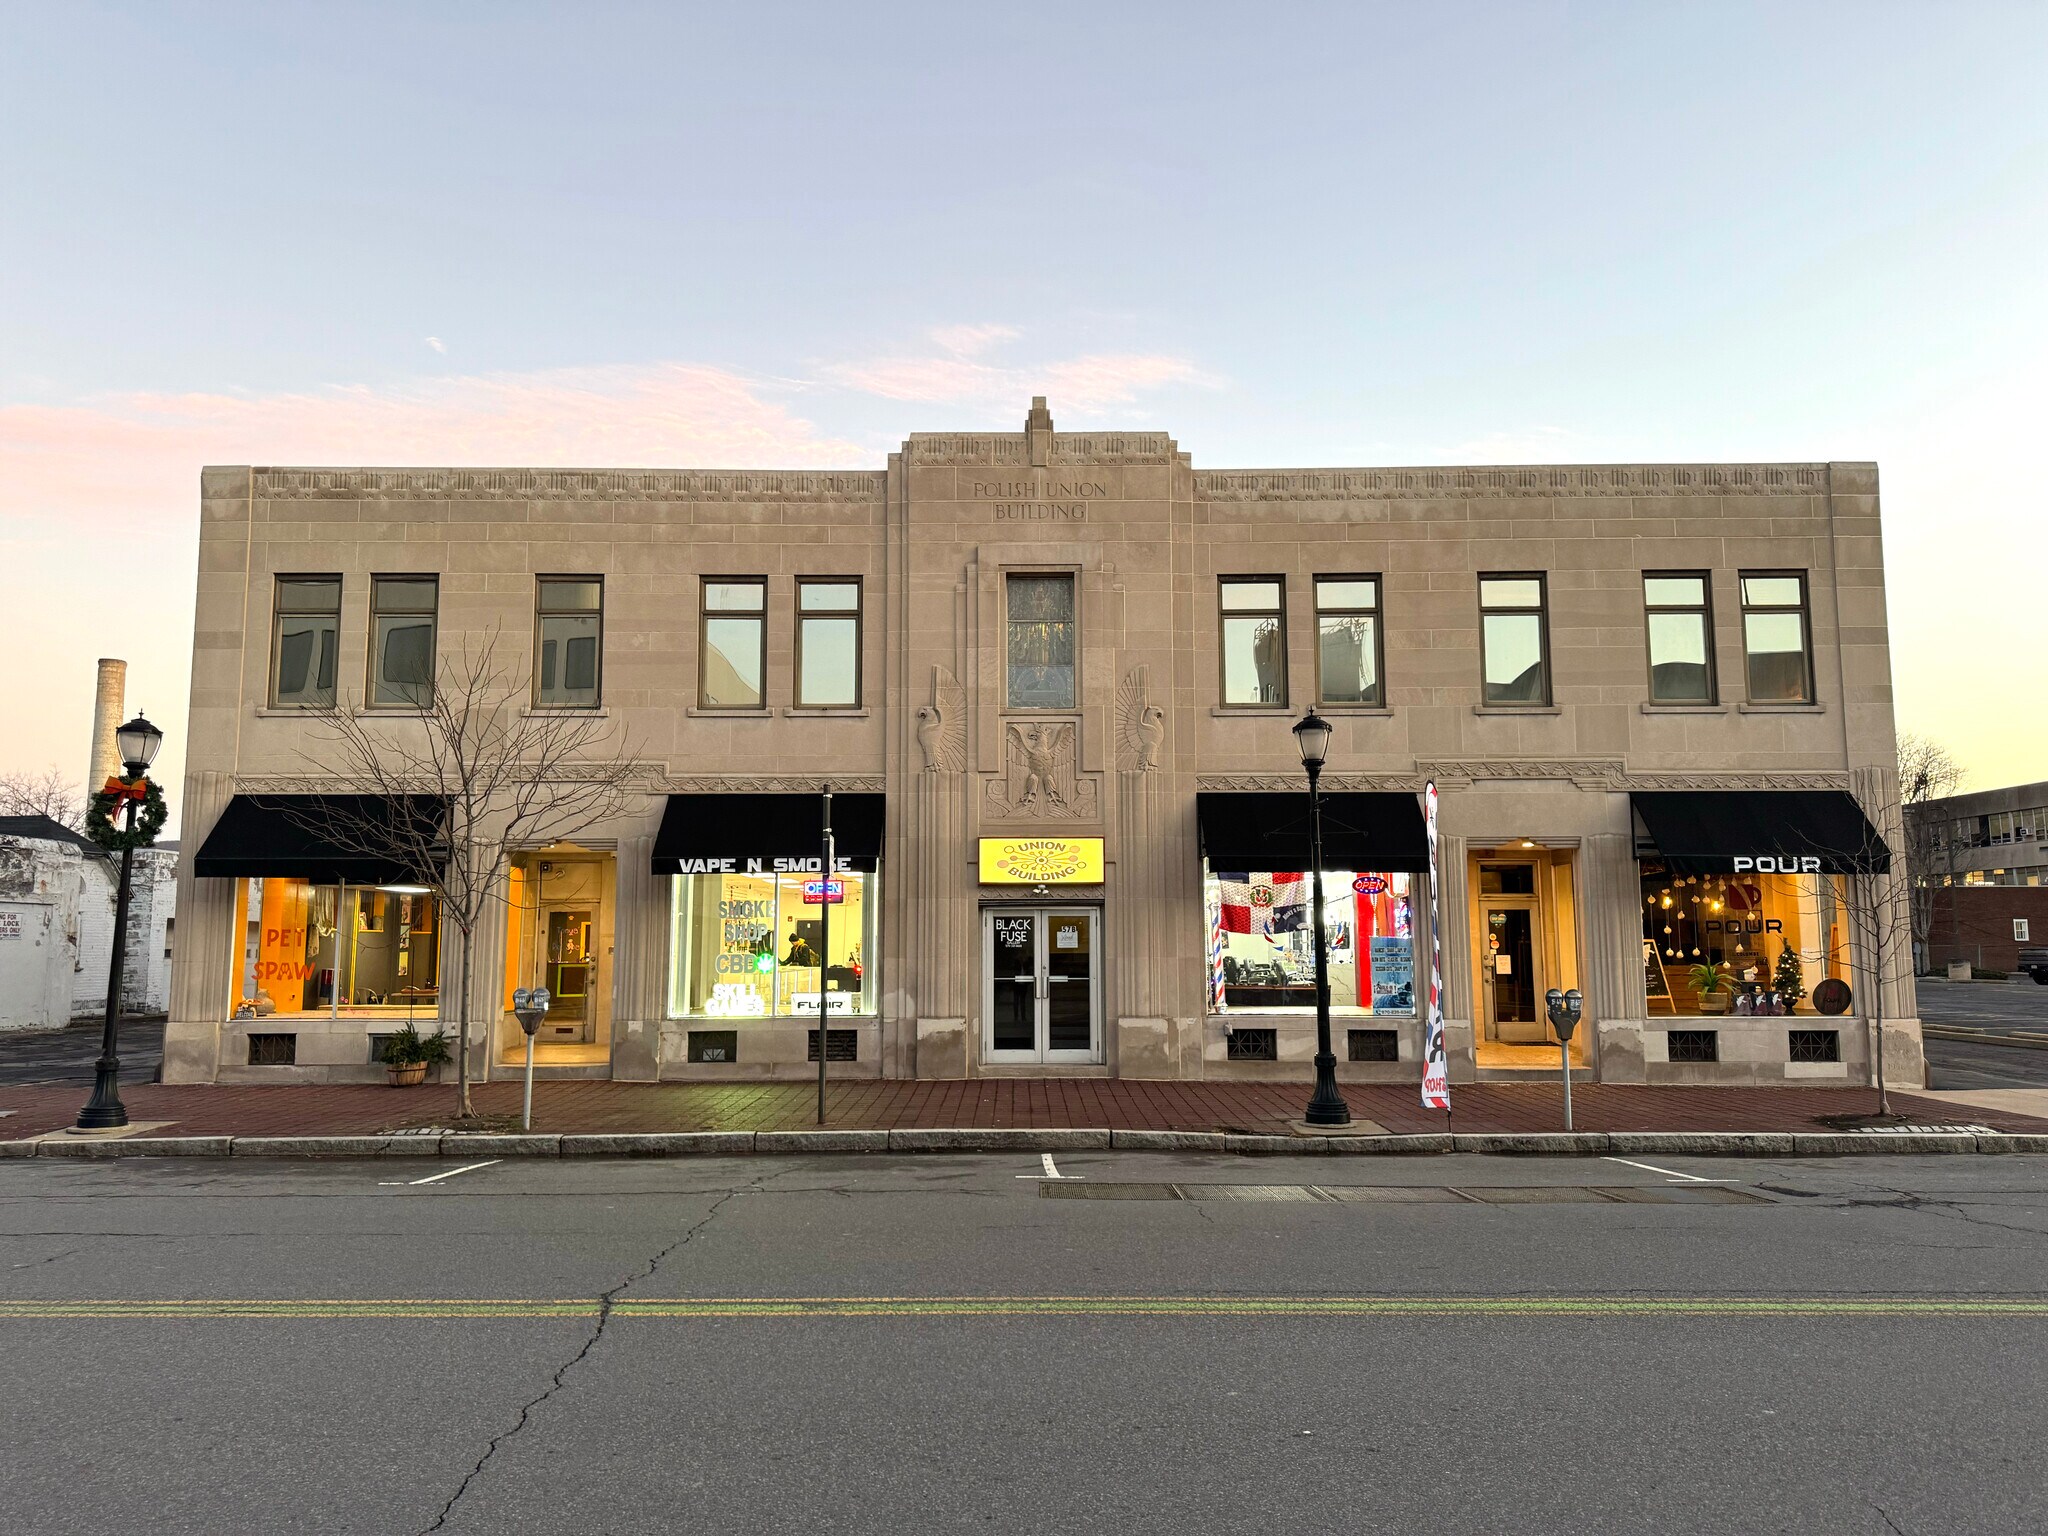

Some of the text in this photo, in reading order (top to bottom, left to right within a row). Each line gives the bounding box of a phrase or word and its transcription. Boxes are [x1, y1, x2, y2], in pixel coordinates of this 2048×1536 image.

[974, 482, 1106, 497] POLISH UNION
[995, 504, 1085, 520] BUILDING
[1018, 841, 1067, 852] UNION
[679, 858, 736, 873] VAPE
[747, 857, 762, 873] N
[1733, 856, 1821, 873] POUR
[1008, 866, 1077, 881] BUILDING
[1355, 881, 1385, 890] OPEN
[718, 900, 775, 918] SMOKE
[724, 923, 768, 942] SHOP
[996, 919, 1031, 930] BLACK
[1705, 919, 1783, 934] POUR
[266, 928, 305, 947] PET
[1000, 931, 1027, 942] FUSE
[251, 961, 316, 981] SPAW
[715, 953, 758, 975] CBD
[712, 983, 762, 1000] SKILL
[705, 998, 765, 1016] GAMES
